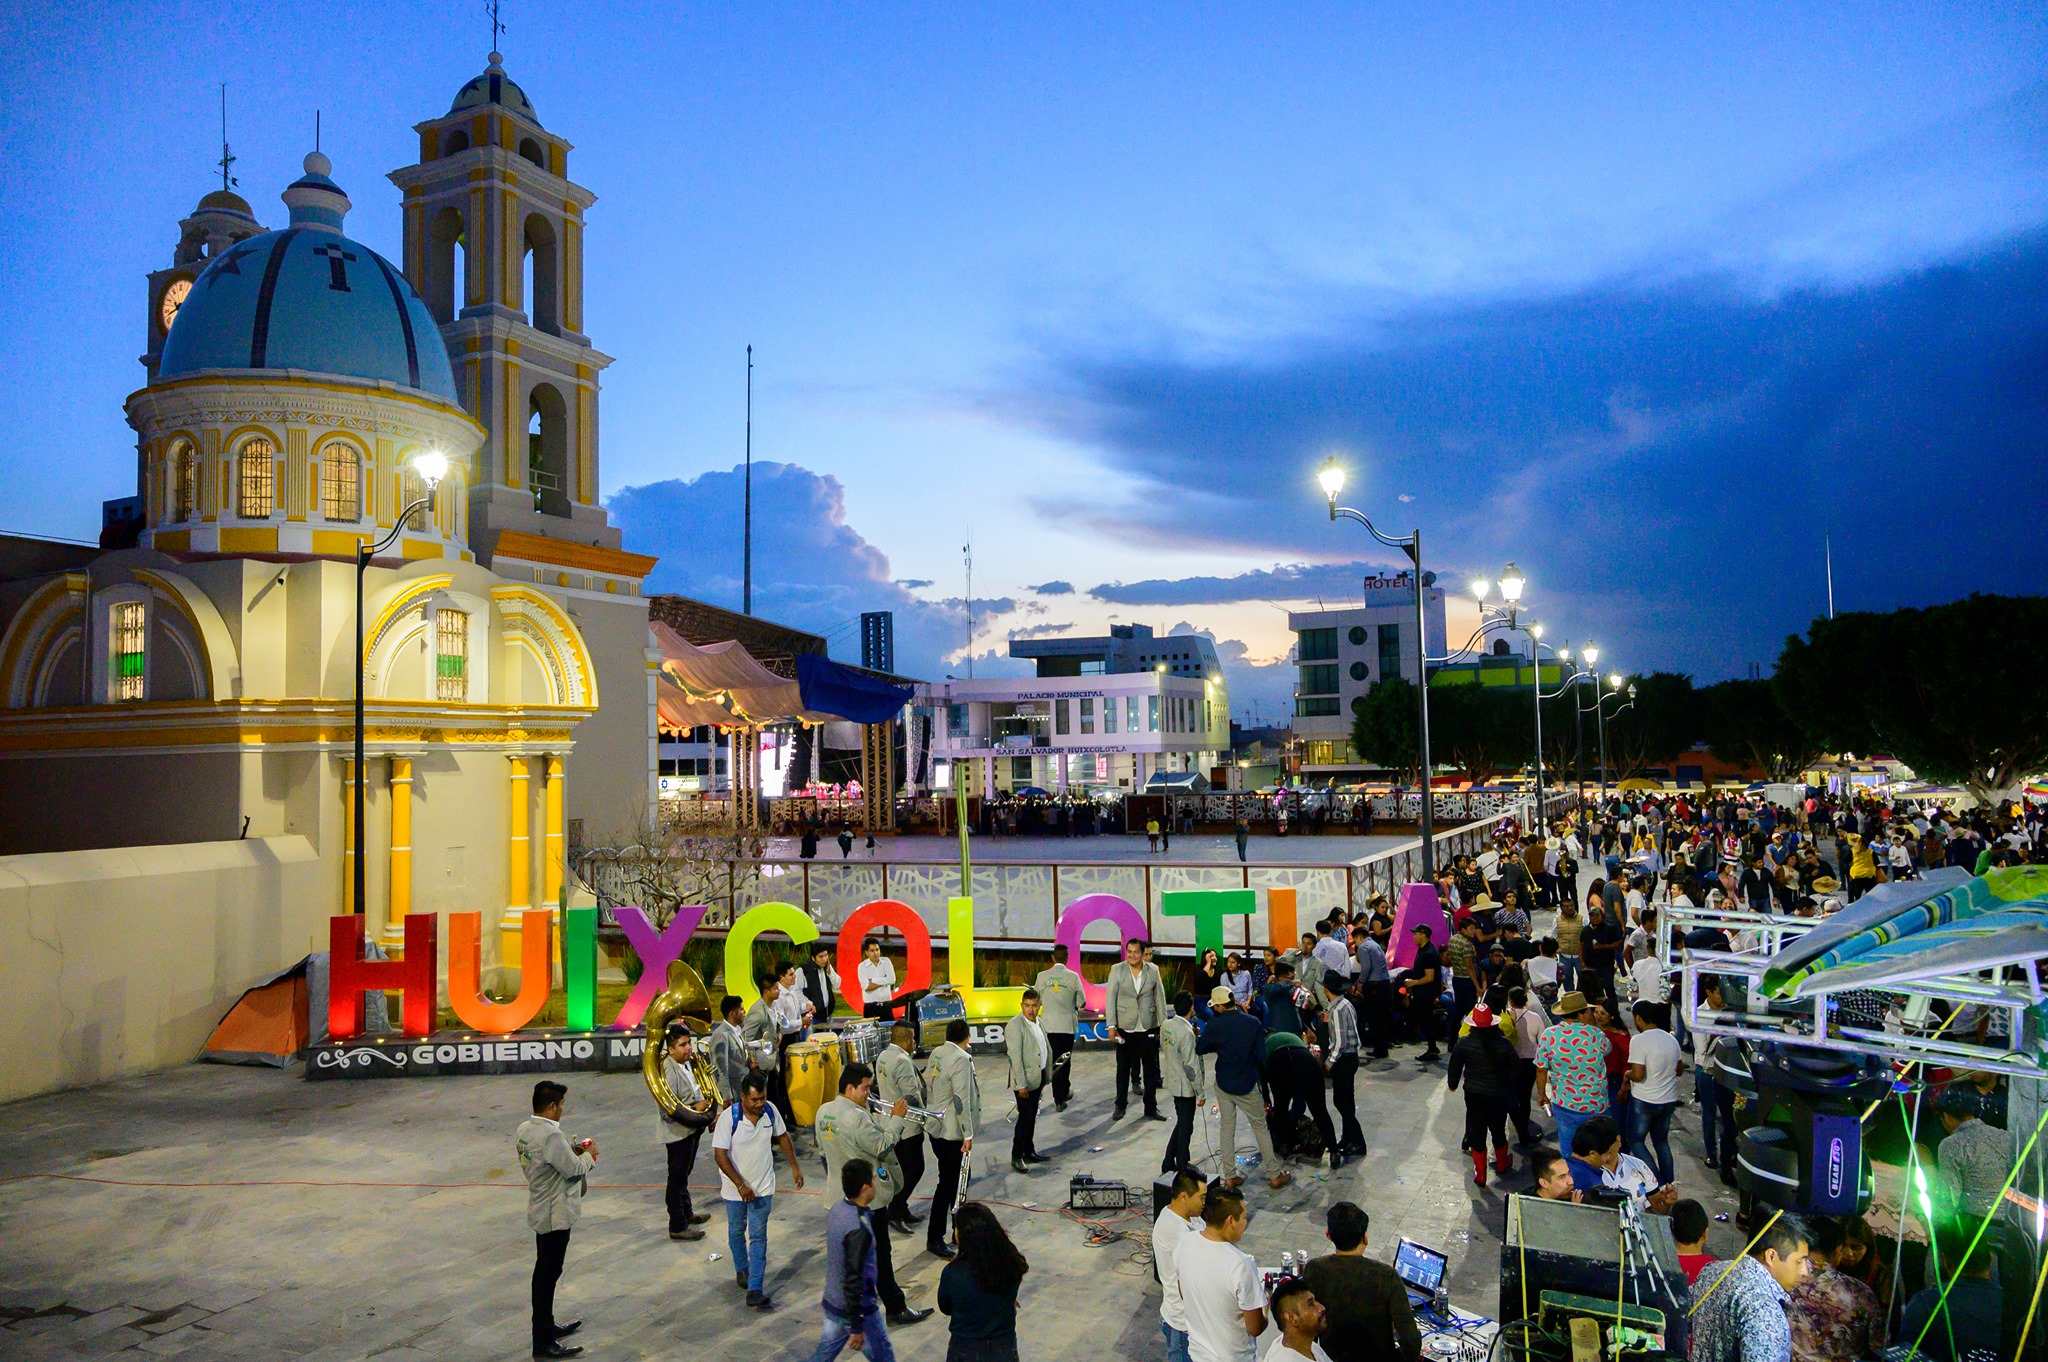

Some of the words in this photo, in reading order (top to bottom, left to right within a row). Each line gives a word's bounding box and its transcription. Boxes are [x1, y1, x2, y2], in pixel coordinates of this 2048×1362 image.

[1364, 578, 1408, 590] HOTEL
[1017, 692, 1055, 700] PALACIO
[1056, 690, 1104, 699] MUNICIPAL
[996, 748, 1015, 756] SAN
[1019, 747, 1065, 755] SALVADOR
[1067, 745, 1127, 754] HUIXCOLOTLA
[412, 1040, 594, 1065] GOBIERNO
